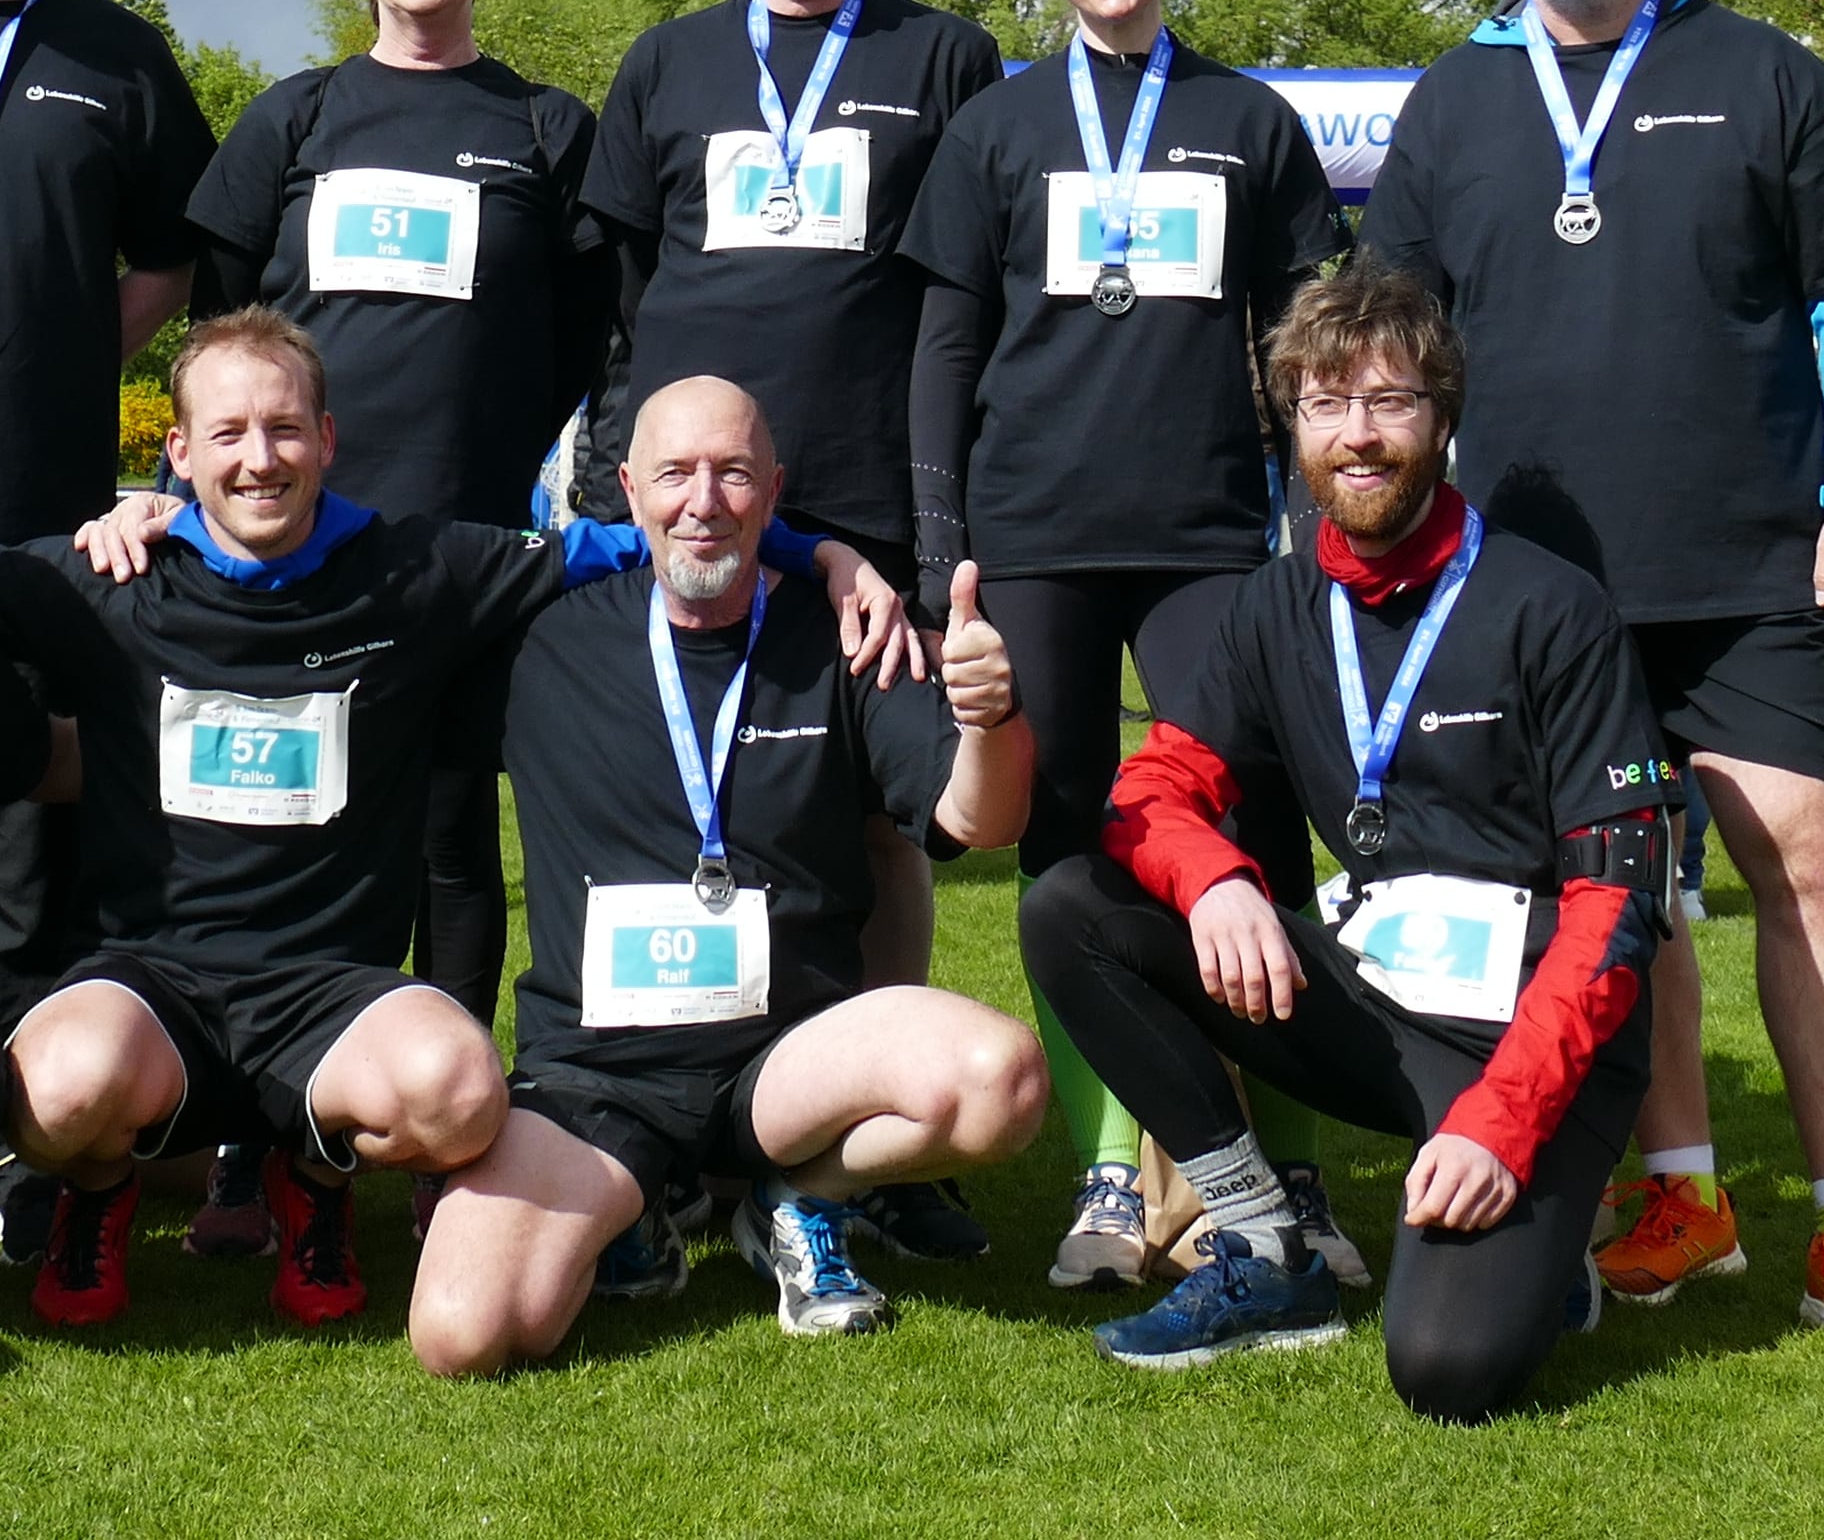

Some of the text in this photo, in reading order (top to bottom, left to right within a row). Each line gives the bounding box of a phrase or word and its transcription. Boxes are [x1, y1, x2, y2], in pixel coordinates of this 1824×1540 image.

[370, 208, 410, 238] 51
[378, 242, 401, 256] Iris
[231, 731, 279, 764] 57
[231, 769, 275, 785] Falko
[1606, 763, 1641, 790] be
[649, 927, 696, 963] 60
[657, 968, 690, 984] Ralf
[1205, 1174, 1257, 1201] Jeep
